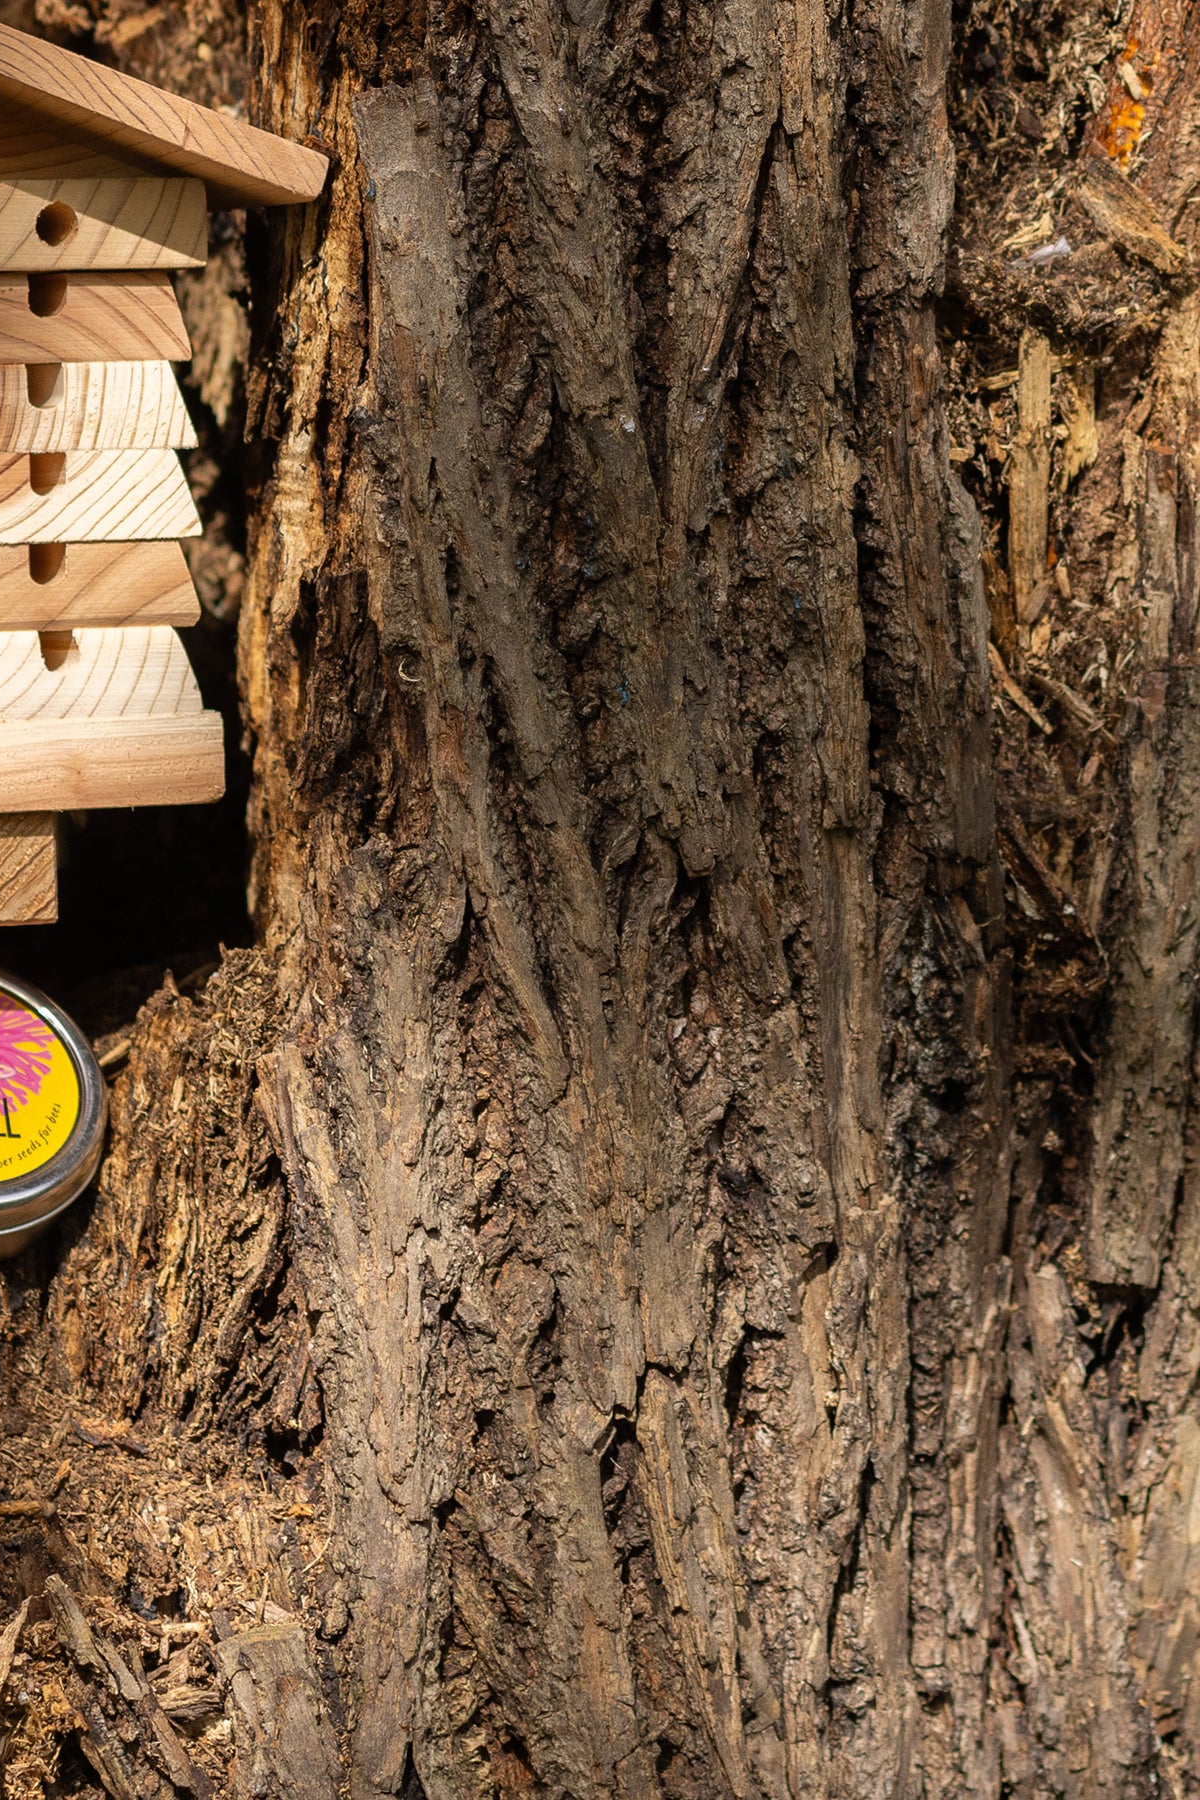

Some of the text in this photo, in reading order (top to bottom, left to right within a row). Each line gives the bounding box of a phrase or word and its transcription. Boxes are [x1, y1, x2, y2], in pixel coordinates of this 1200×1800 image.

[17, 1141, 42, 1161] seeds
[37, 1124, 53, 1146] for
[50, 1102, 62, 1131] bees
